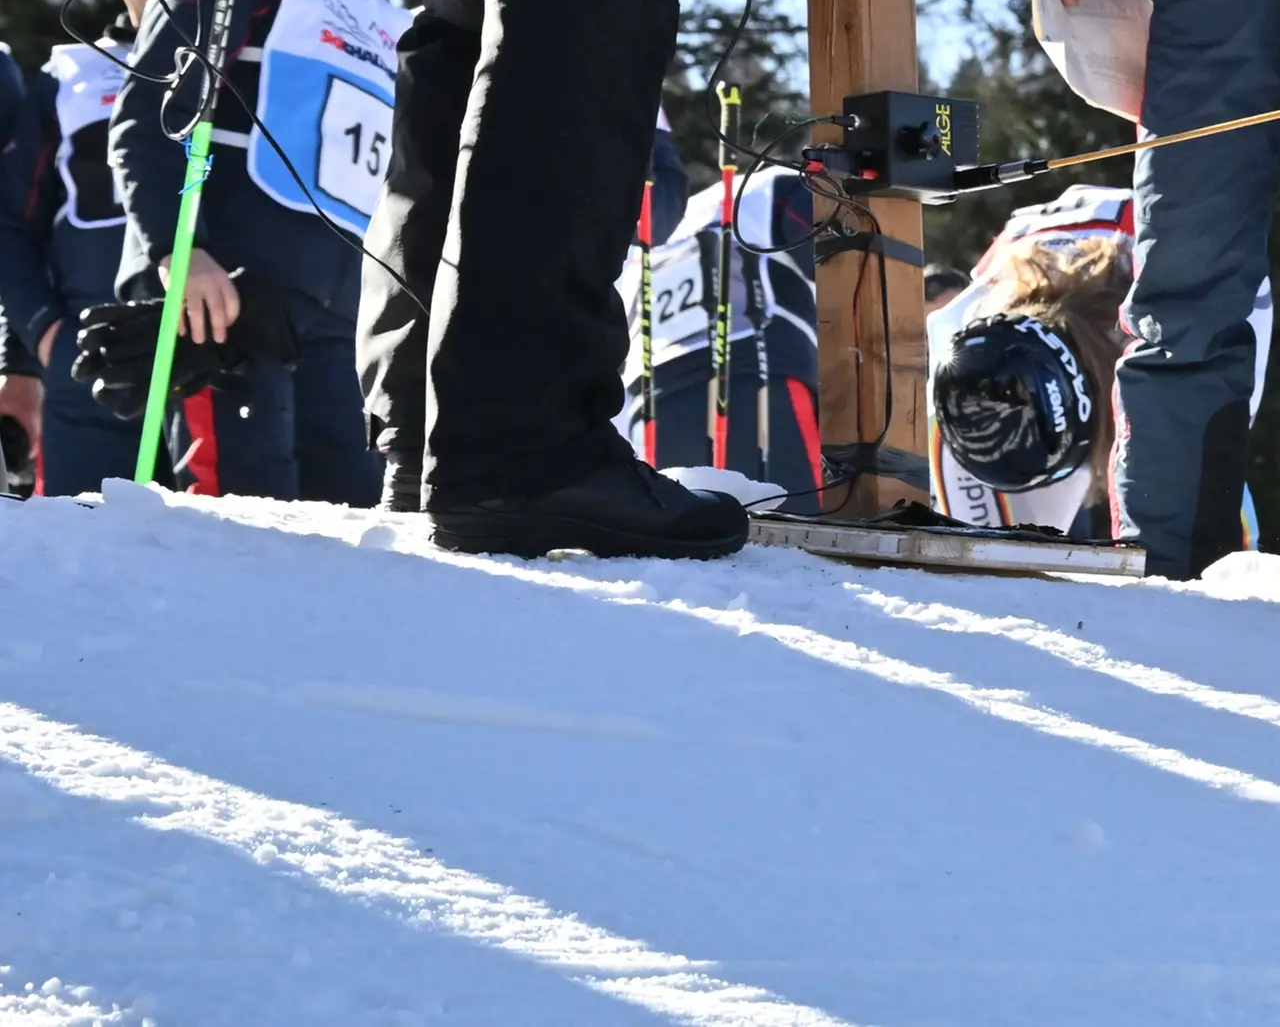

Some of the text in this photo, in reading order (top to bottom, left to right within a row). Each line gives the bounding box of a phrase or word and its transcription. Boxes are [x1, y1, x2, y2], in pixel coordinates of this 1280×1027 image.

[344, 123, 386, 177] 15
[935, 103, 951, 156] ALGE
[656, 278, 699, 324] 22
[1045, 379, 1067, 433] uvex
